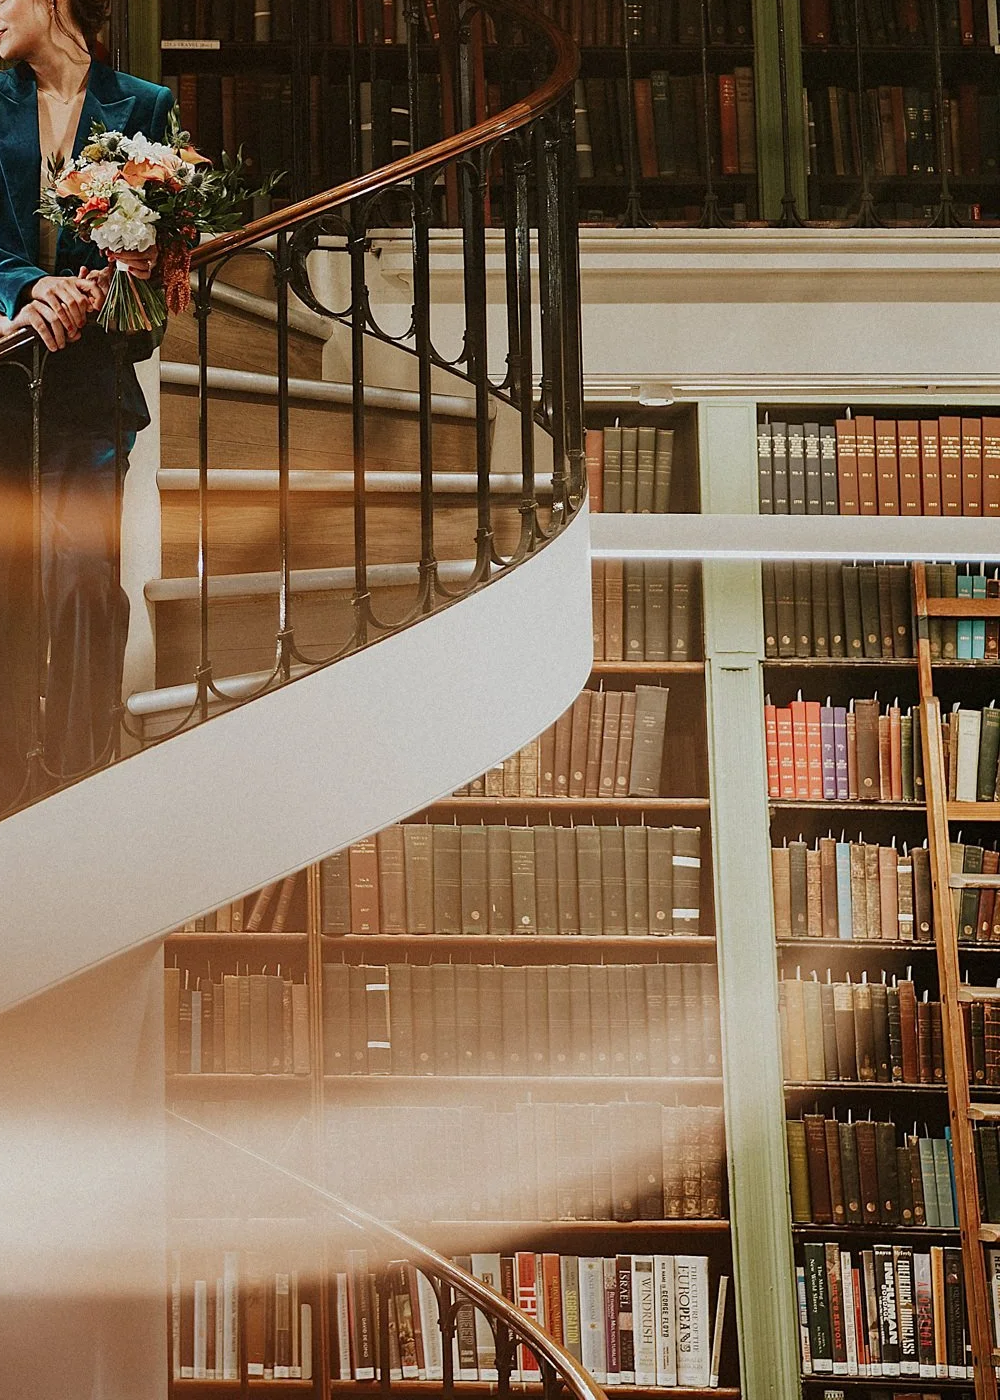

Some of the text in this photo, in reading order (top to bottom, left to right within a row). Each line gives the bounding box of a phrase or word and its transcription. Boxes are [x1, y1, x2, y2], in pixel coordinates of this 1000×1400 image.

[618, 1270, 631, 1308] ISRAEL
[881, 1284, 889, 1321] BONDAGE
[884, 1261, 898, 1345] INHUMAN
[897, 1260, 913, 1305] FREDERICK
[565, 1290, 579, 1344] SEGREGATION
[641, 1277, 653, 1344] WINDRUSH
[677, 1265, 691, 1353] EUROPEANS
[692, 1322, 698, 1335] OF
[833, 1313, 842, 1349] REVOLT
[900, 1309, 915, 1355] DOUGLASS
